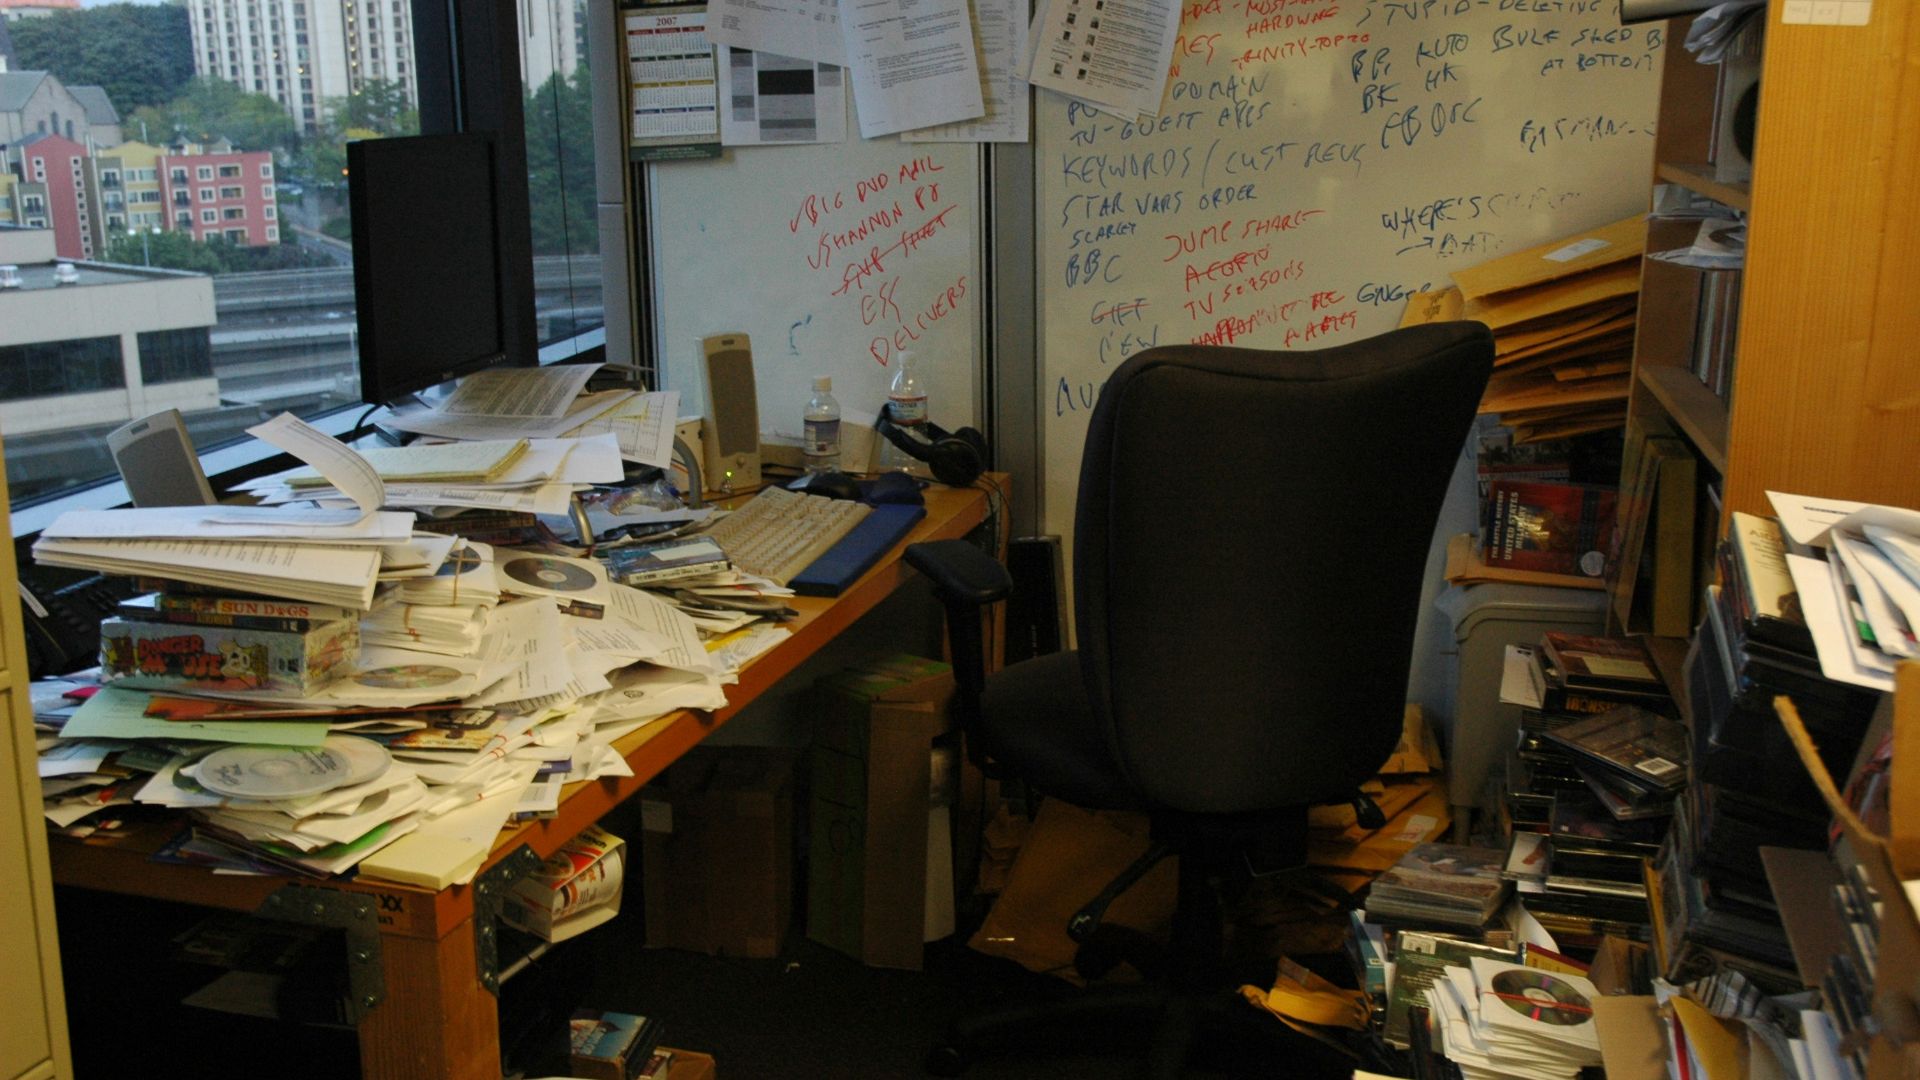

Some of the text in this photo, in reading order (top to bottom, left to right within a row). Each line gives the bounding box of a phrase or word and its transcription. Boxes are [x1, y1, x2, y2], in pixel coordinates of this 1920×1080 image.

[656, 16, 678, 27] 2007
[1198, 183, 1259, 212] ORDER
[1503, 490, 1520, 561] UNITED STATES
[221, 600, 259, 617] SUN
[136, 634, 205, 657] DANGER
